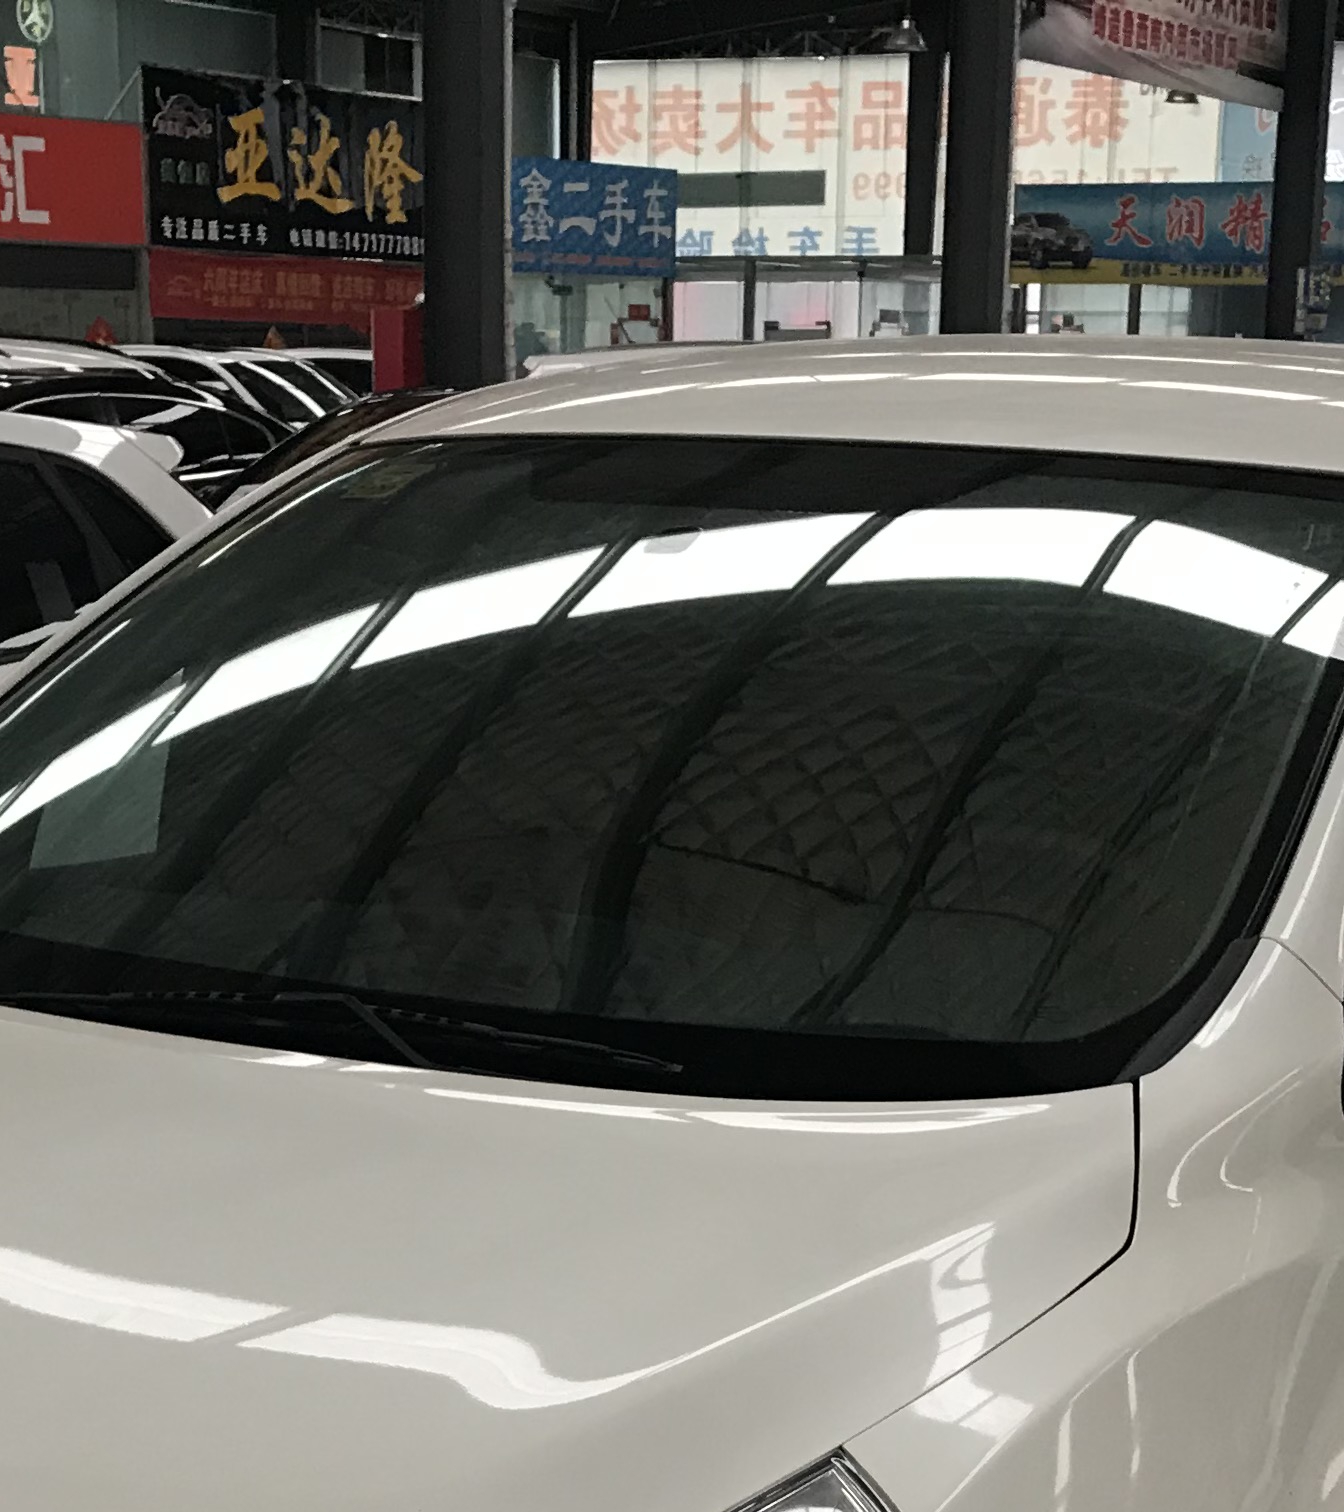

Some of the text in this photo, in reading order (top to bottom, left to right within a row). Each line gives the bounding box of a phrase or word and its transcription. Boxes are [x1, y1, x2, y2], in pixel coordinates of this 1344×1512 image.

[216, 107, 424, 225] 亚达隆
[518, 168, 673, 249] 鑫二手车
